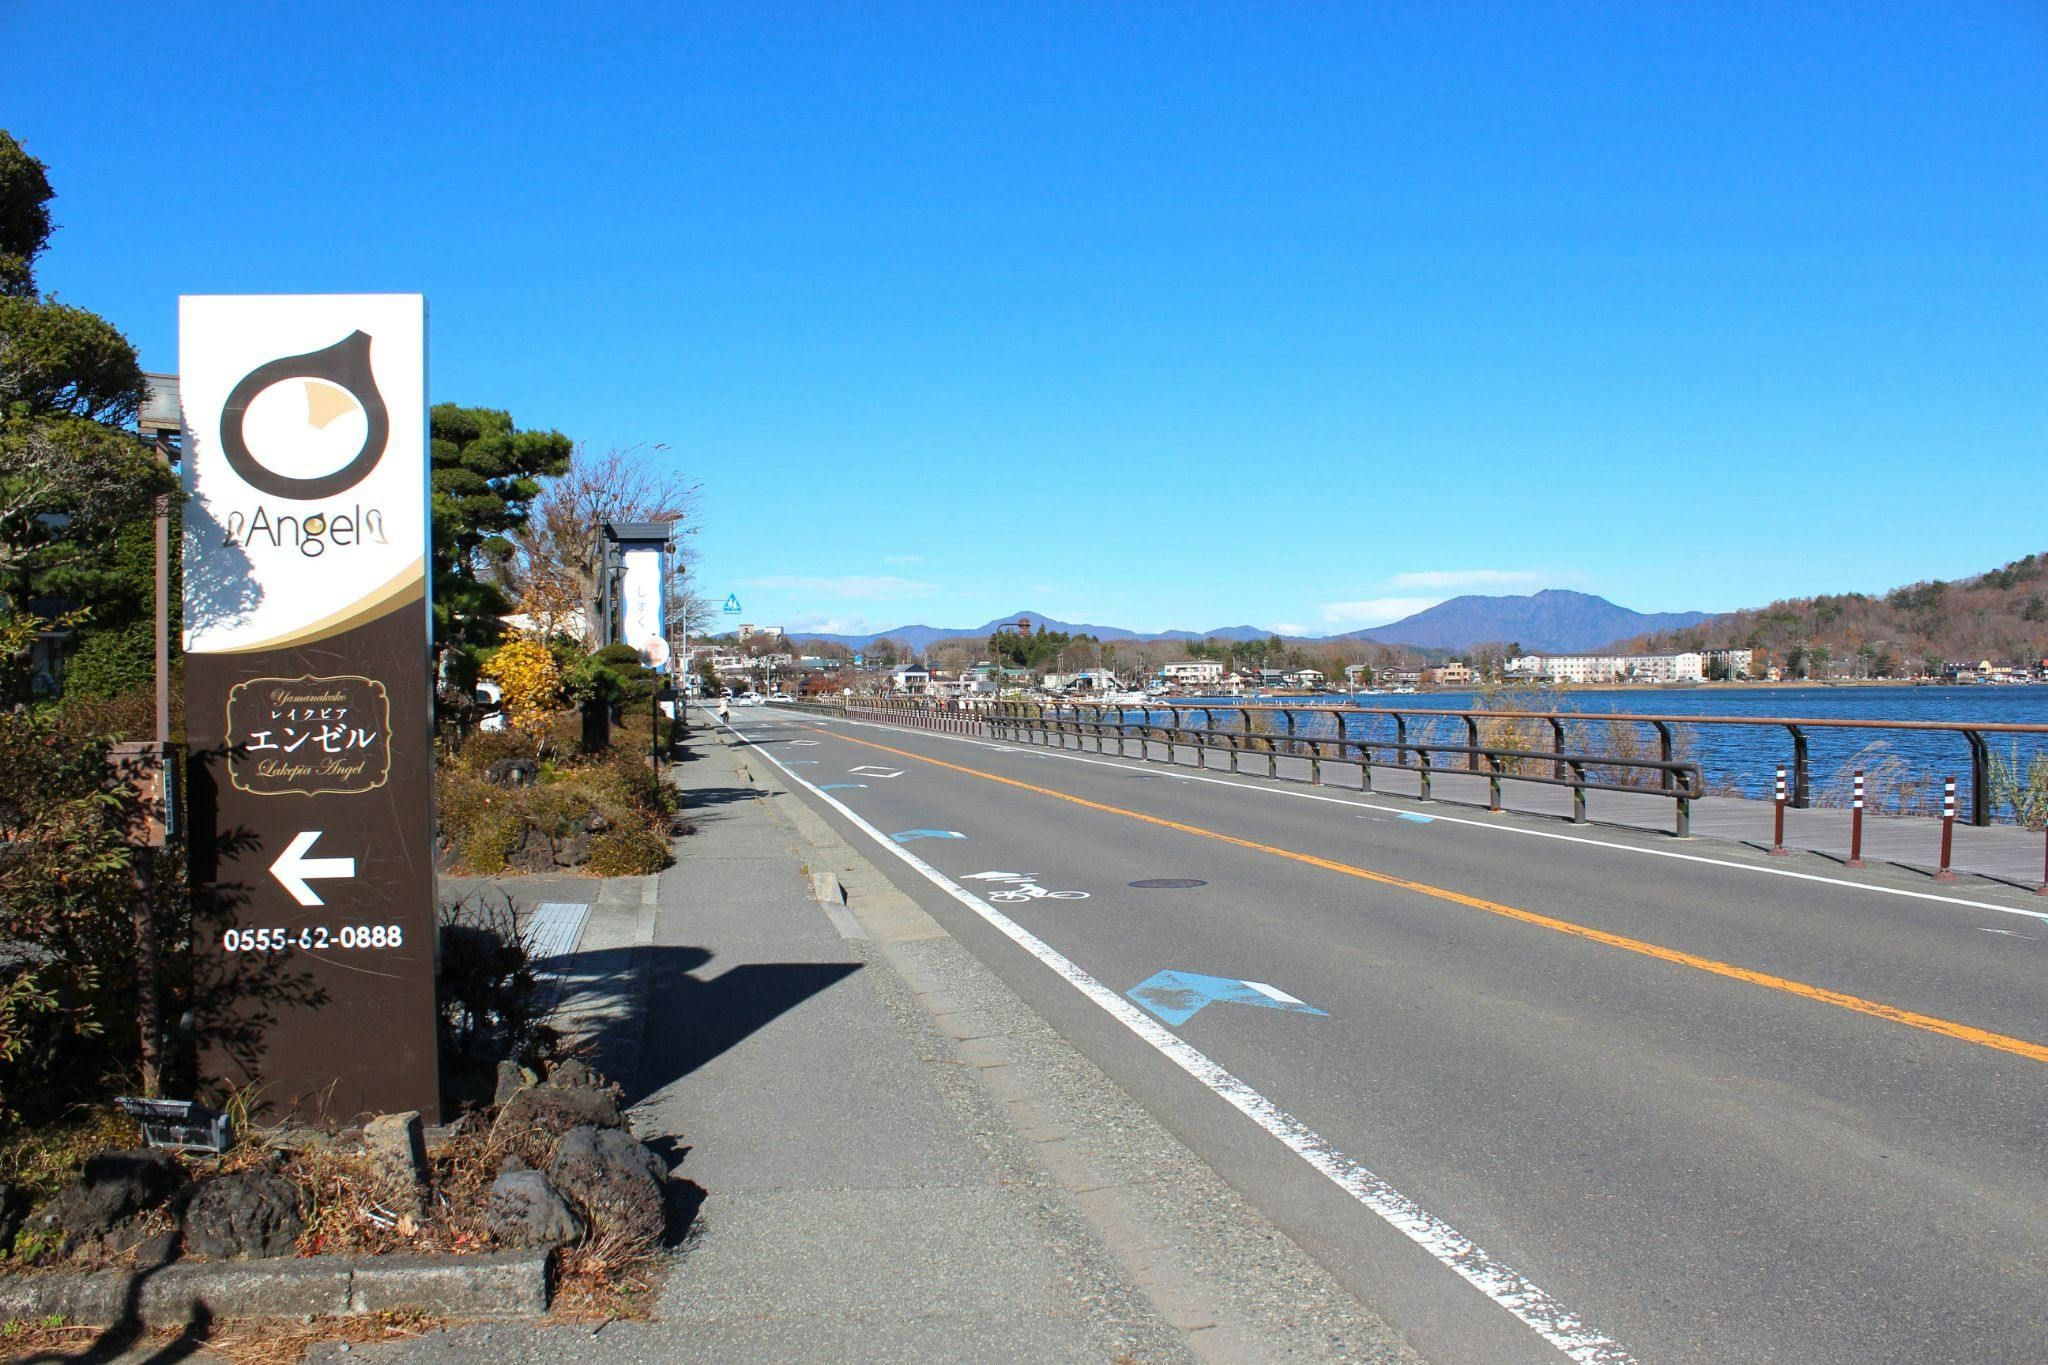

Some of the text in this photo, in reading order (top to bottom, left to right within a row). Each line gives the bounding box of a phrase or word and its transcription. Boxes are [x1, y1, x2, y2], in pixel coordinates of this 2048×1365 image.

[245, 504, 360, 558] Angel
[270, 688, 347, 706] Yamanakako
[271, 708, 347, 721] レイクピア
[245, 723, 377, 753] エンゼル
[256, 757, 366, 782] Lakepia Angel
[223, 925, 403, 952] 0555-62-0888
